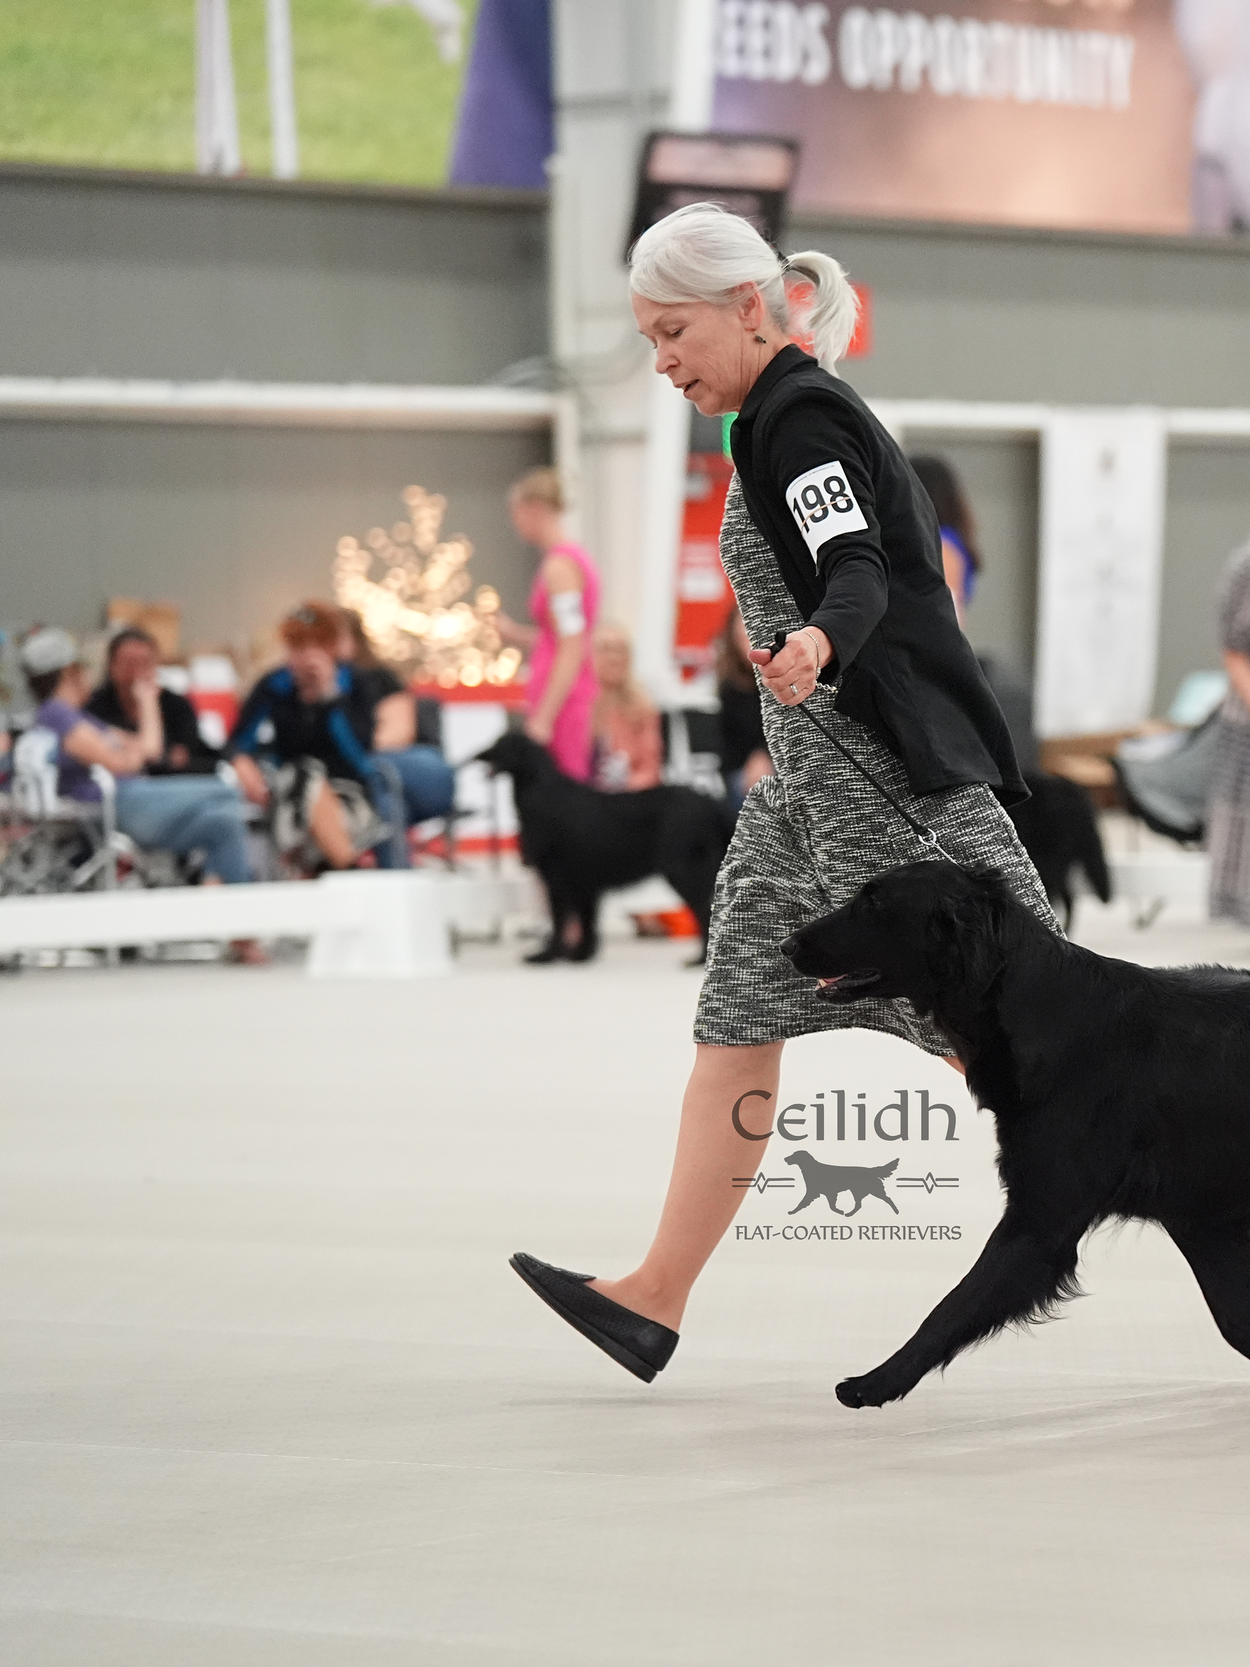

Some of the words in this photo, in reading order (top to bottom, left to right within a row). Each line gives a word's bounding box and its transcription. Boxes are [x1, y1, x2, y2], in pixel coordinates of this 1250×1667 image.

[718, 1, 831, 85] EEDS
[840, 7, 1134, 110] OPPORTUNITY
[793, 476, 853, 533] 198
